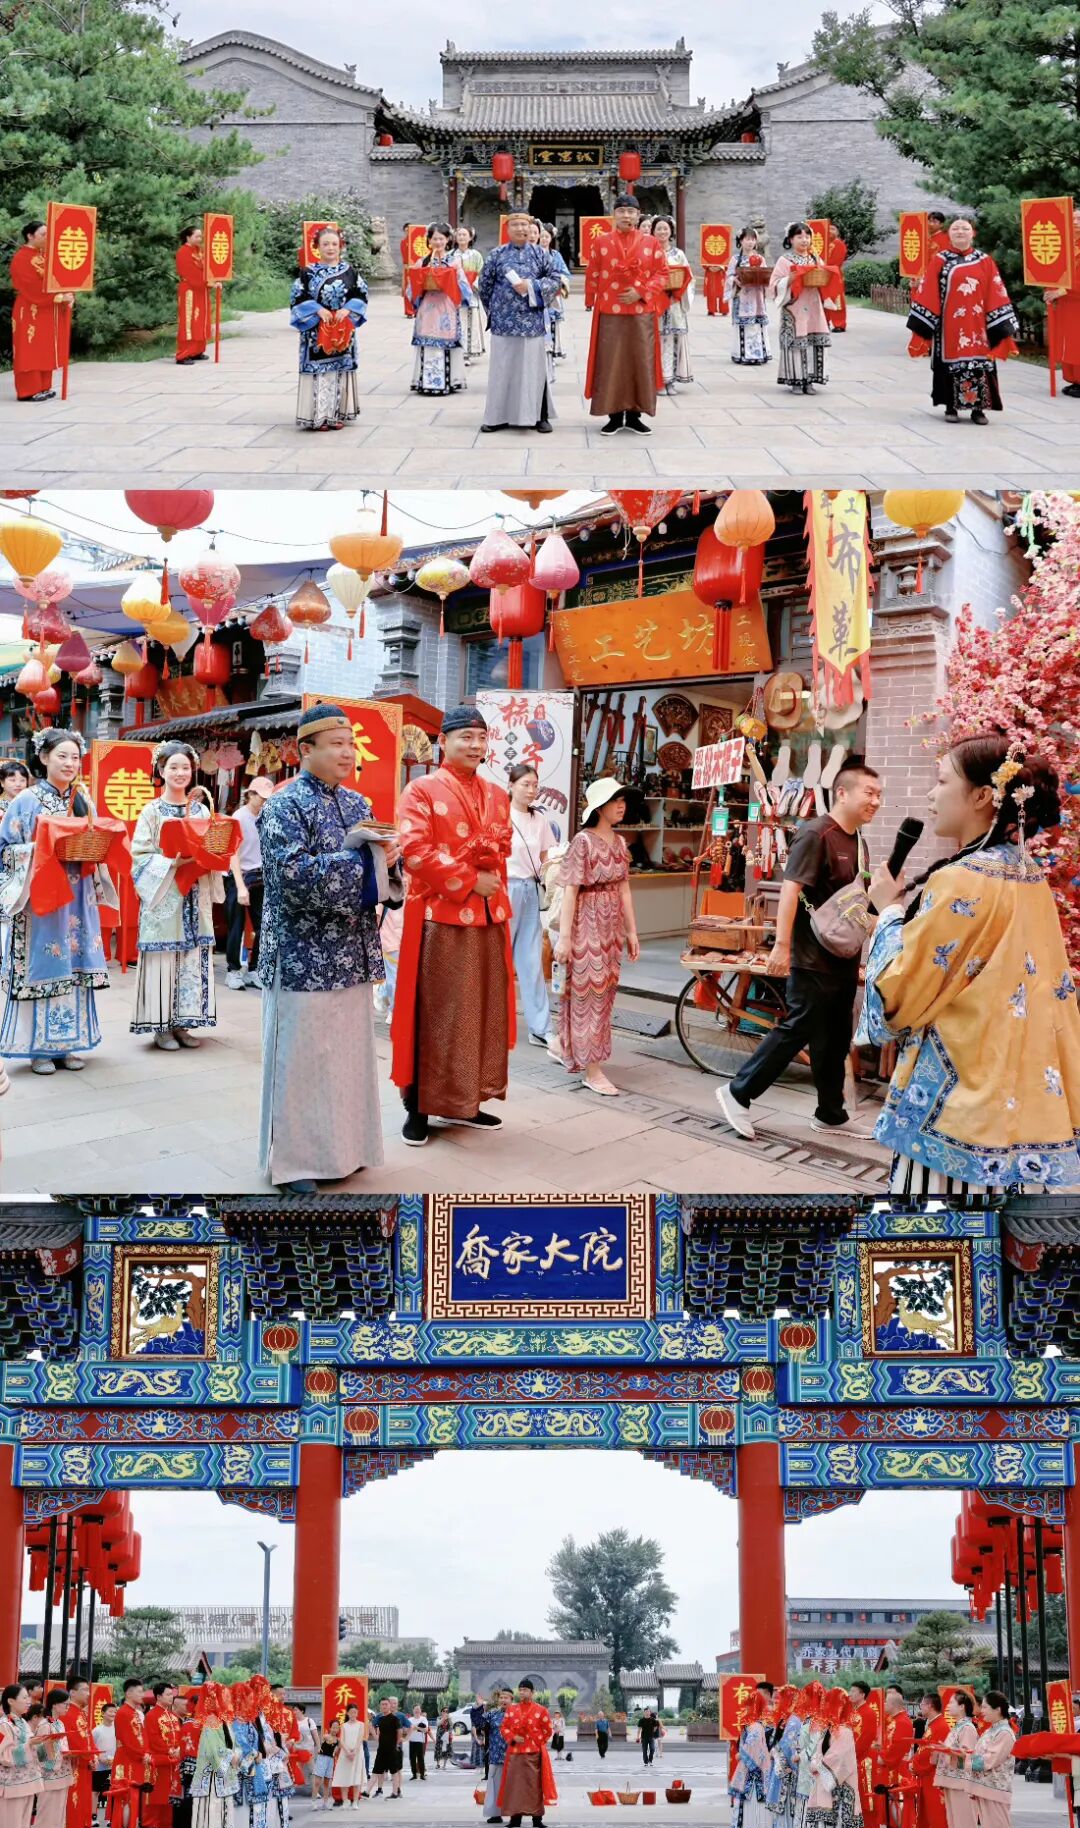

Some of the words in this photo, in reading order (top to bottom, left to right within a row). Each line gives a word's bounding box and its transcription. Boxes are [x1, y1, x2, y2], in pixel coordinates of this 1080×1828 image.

[57, 226, 89, 271] 囍
[211, 230, 230, 265] 囍
[903, 228, 920, 262] 囍
[1029, 219, 1062, 265] 囍
[455, 1223, 624, 1280] 喬家大院
